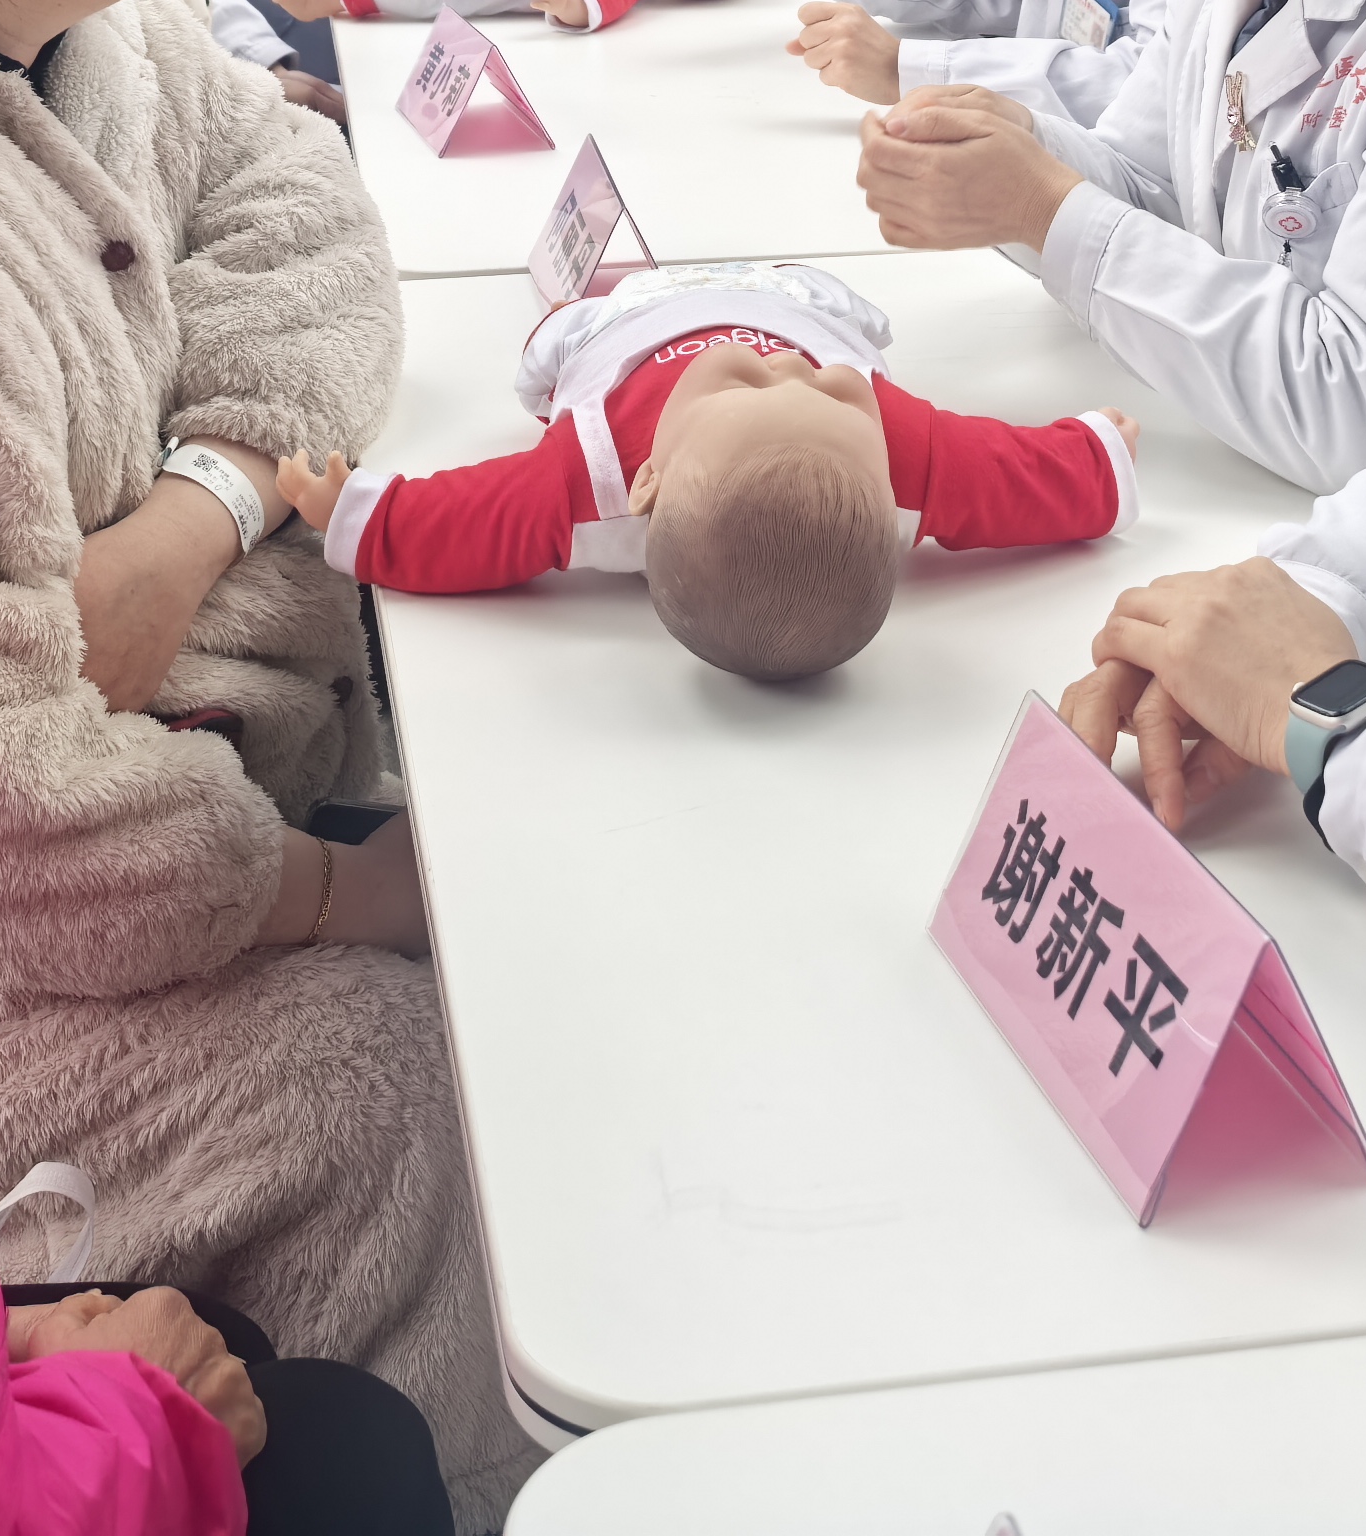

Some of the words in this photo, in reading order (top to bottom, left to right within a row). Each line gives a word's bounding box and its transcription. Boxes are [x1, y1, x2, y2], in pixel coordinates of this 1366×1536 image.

[415, 41, 471, 118] 黄小莉
[981, 798, 1189, 1078] 谢新平
